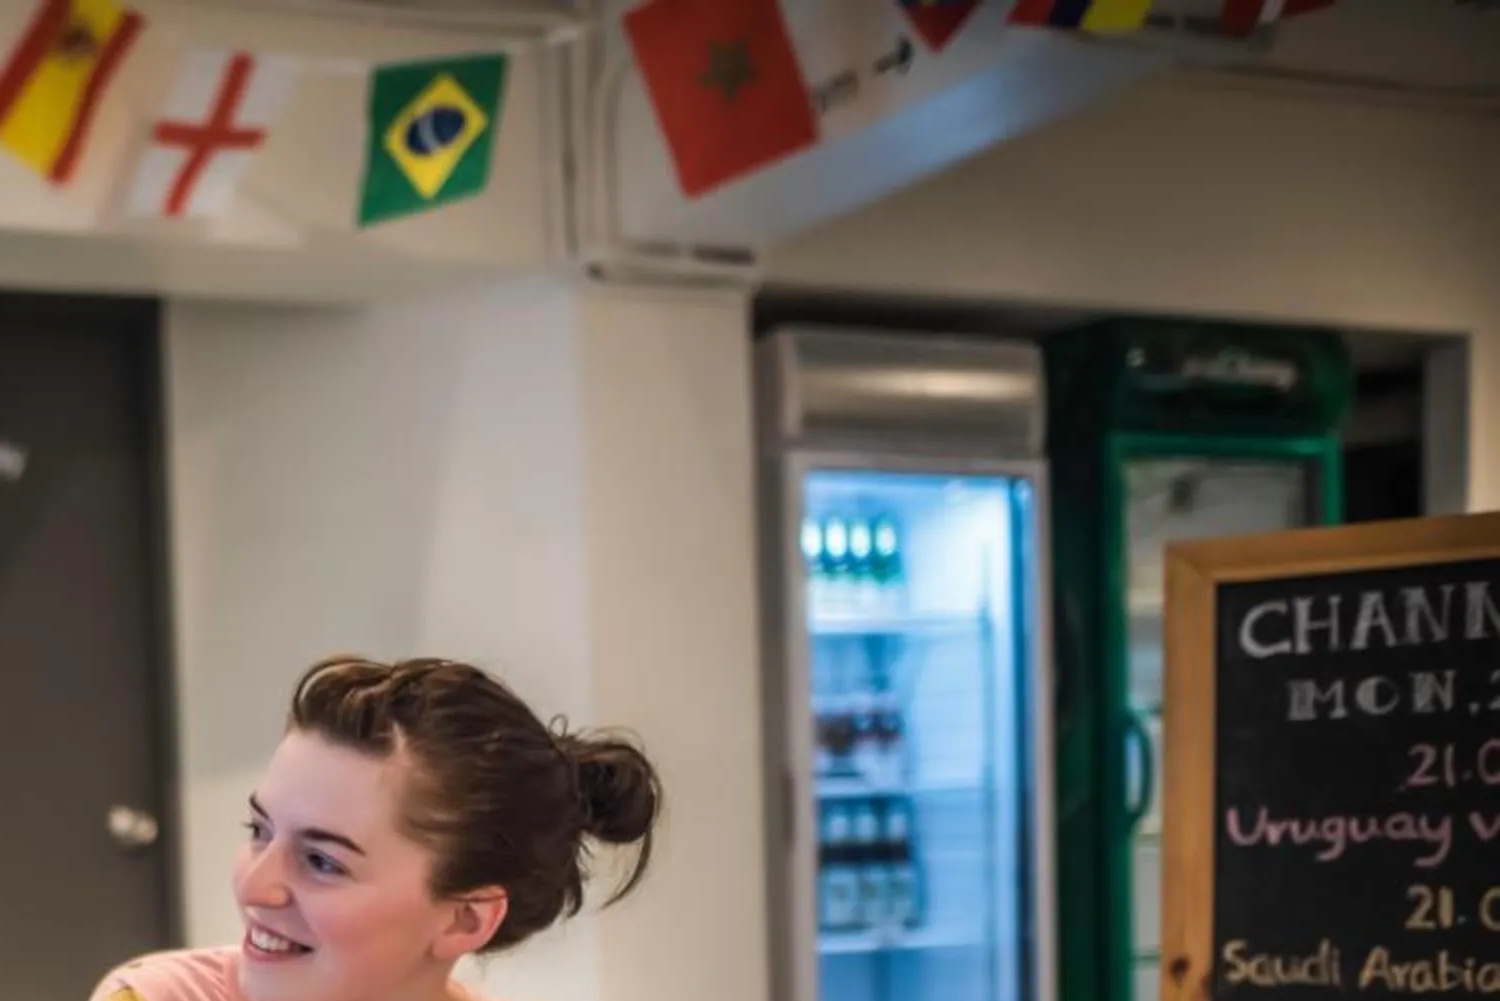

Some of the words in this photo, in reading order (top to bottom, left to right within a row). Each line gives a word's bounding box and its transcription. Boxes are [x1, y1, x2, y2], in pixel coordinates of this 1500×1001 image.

[1238, 580, 1500, 659] CHANN
[1225, 806, 1452, 868] Uruguay
[1221, 937, 1342, 988] Saudi
[1357, 944, 1500, 993] Arabia
